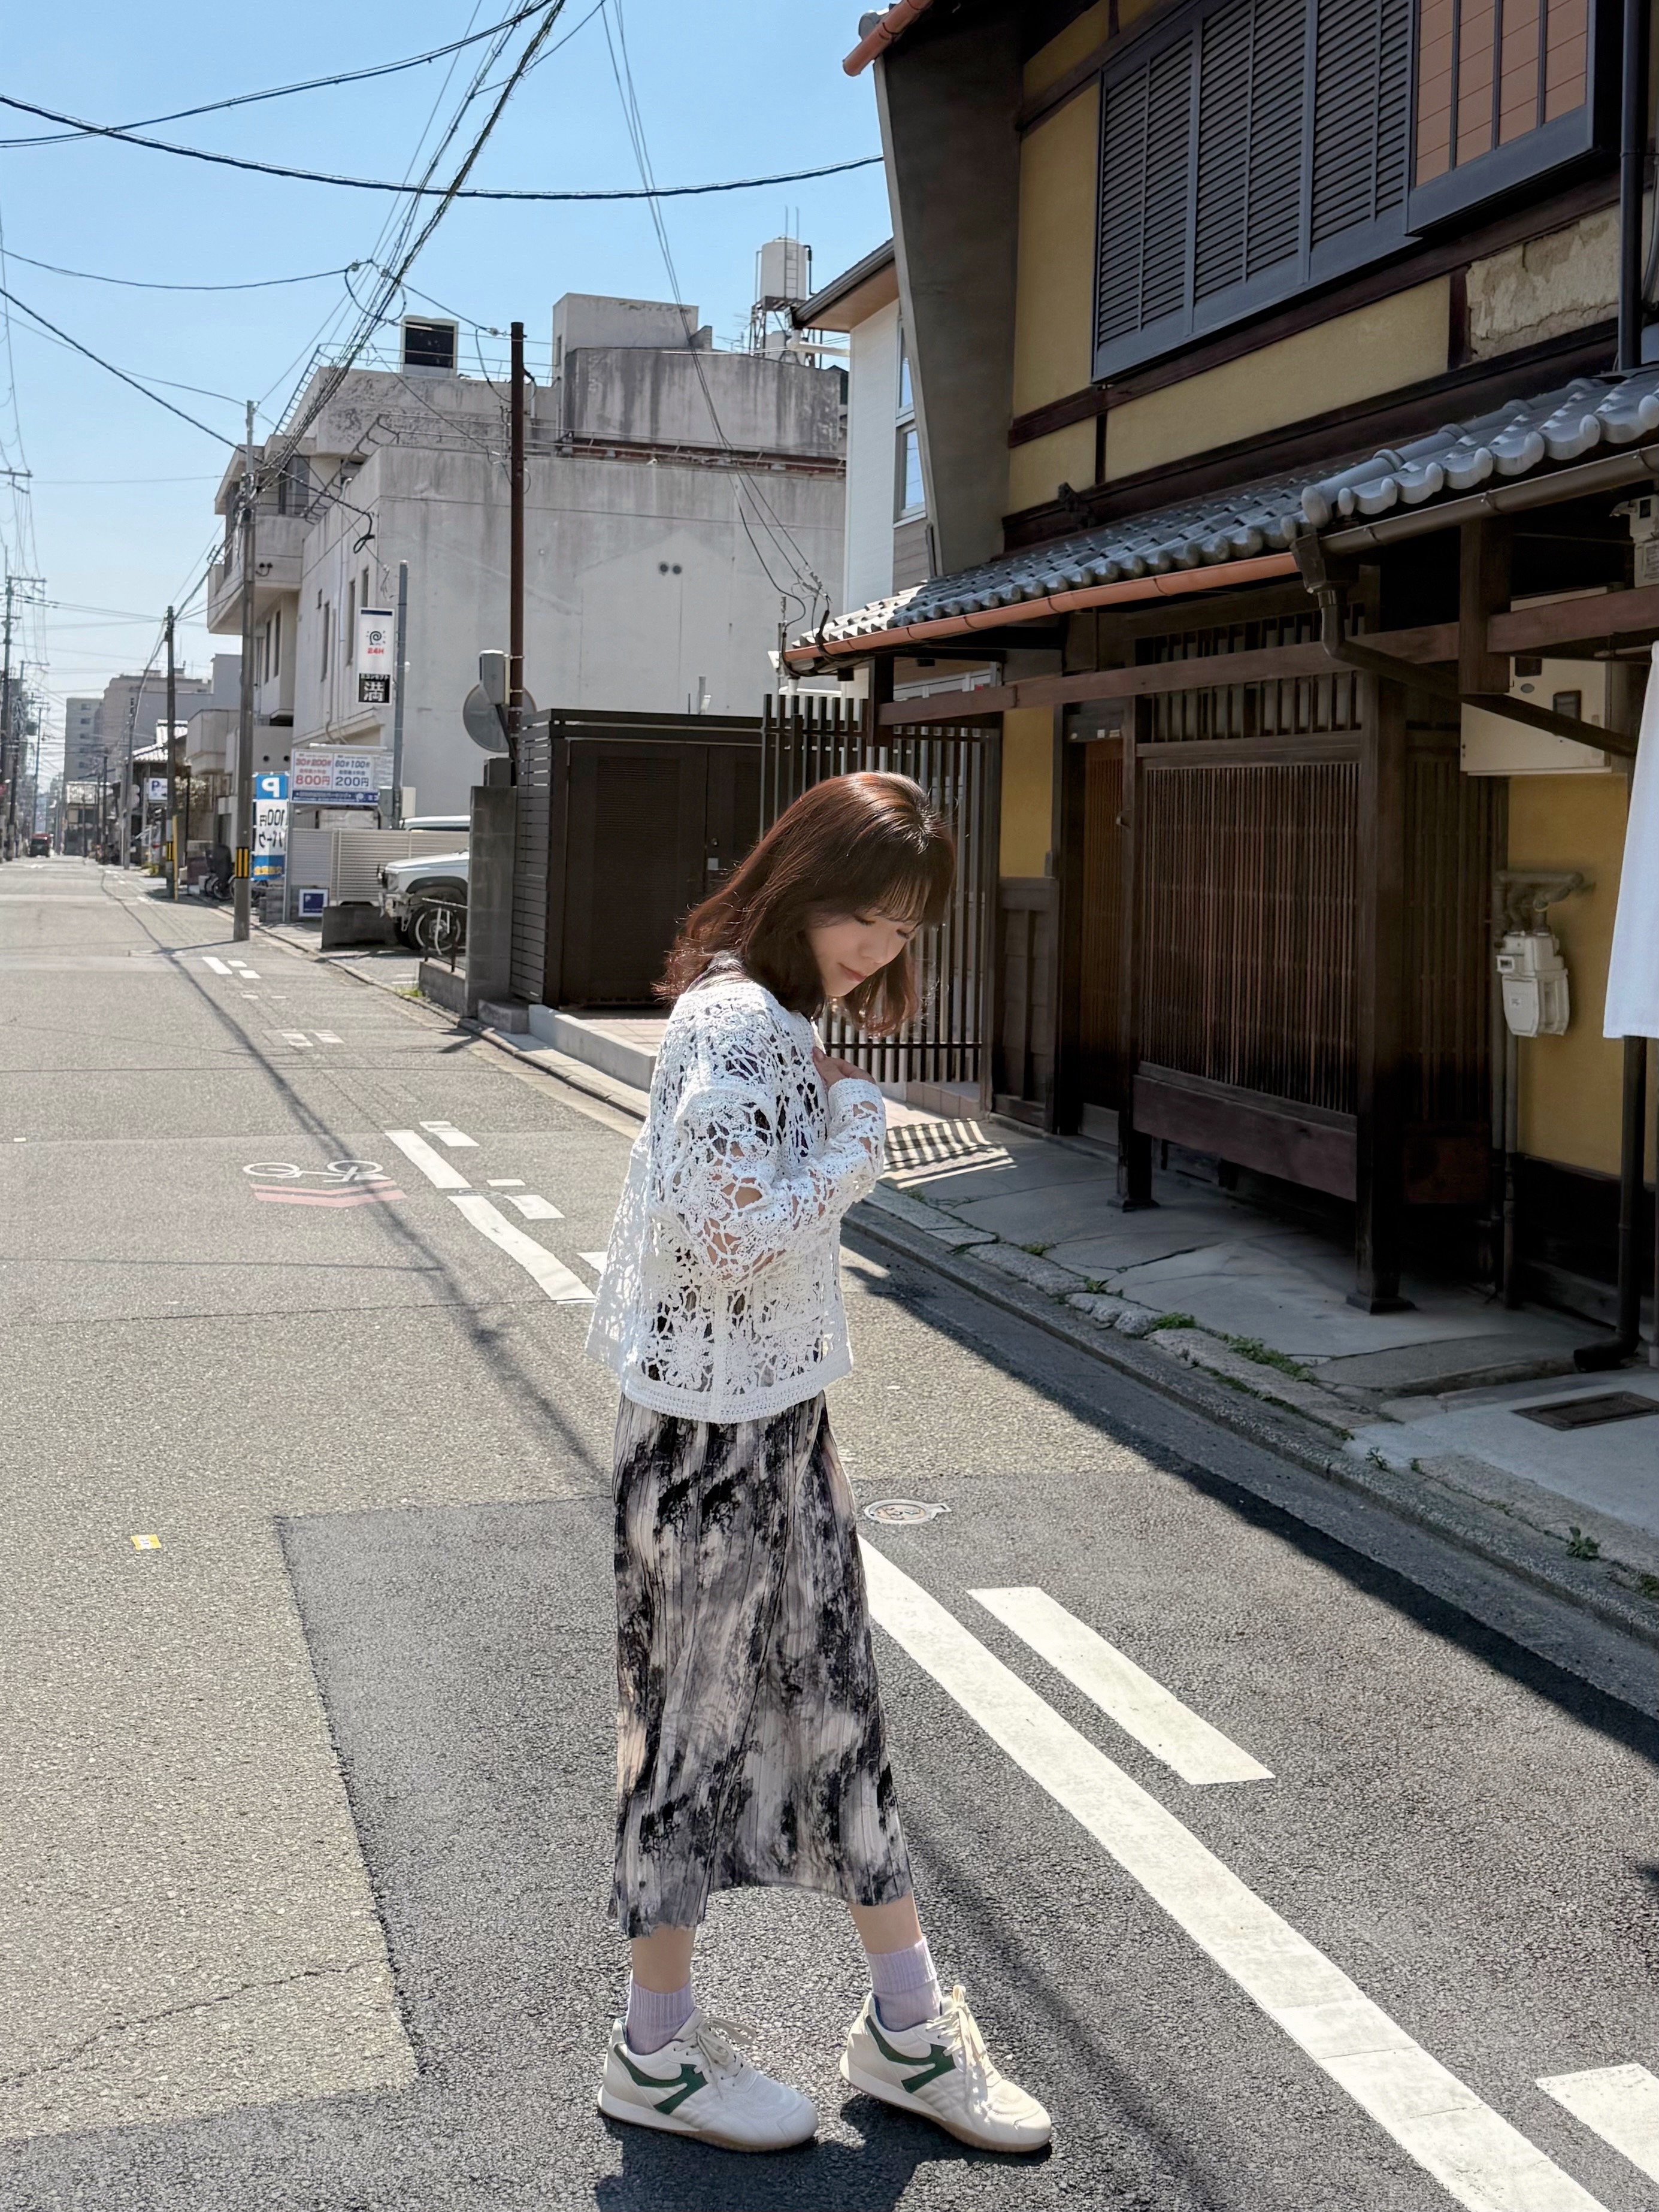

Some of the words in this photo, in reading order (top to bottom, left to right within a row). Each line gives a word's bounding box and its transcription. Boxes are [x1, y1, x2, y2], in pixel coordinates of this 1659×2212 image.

[364, 681, 385, 701] 満
[152, 780, 161, 791] P
[295, 774, 331, 786] 800円
[335, 776, 369, 787] 200円
